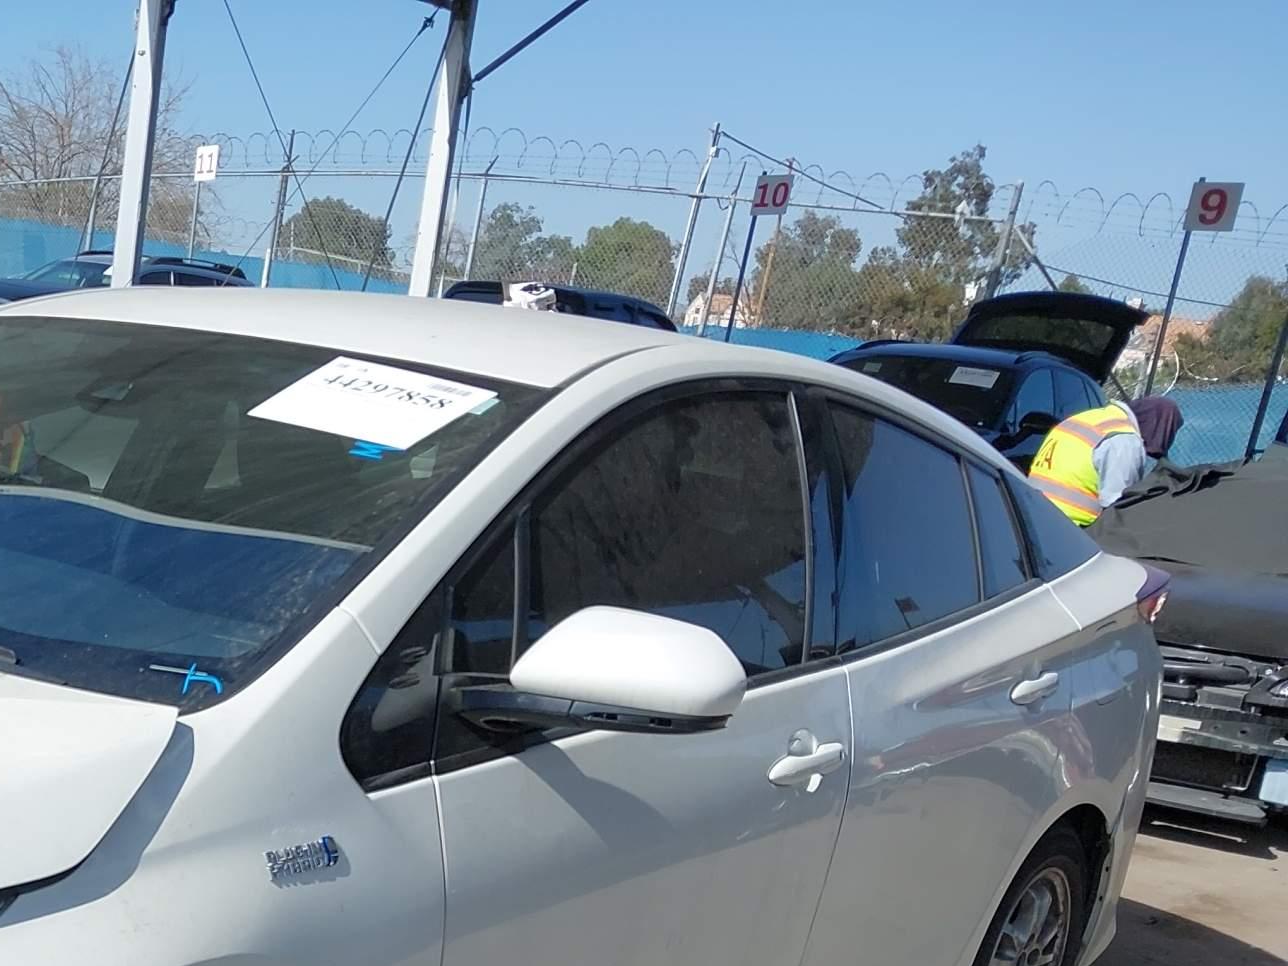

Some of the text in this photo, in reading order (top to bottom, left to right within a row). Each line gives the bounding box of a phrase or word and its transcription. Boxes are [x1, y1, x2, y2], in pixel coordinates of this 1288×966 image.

[196, 152, 214, 174] 11
[754, 182, 789, 207] 10
[1198, 188, 1227, 225] 9
[323, 375, 453, 409] 44297858
